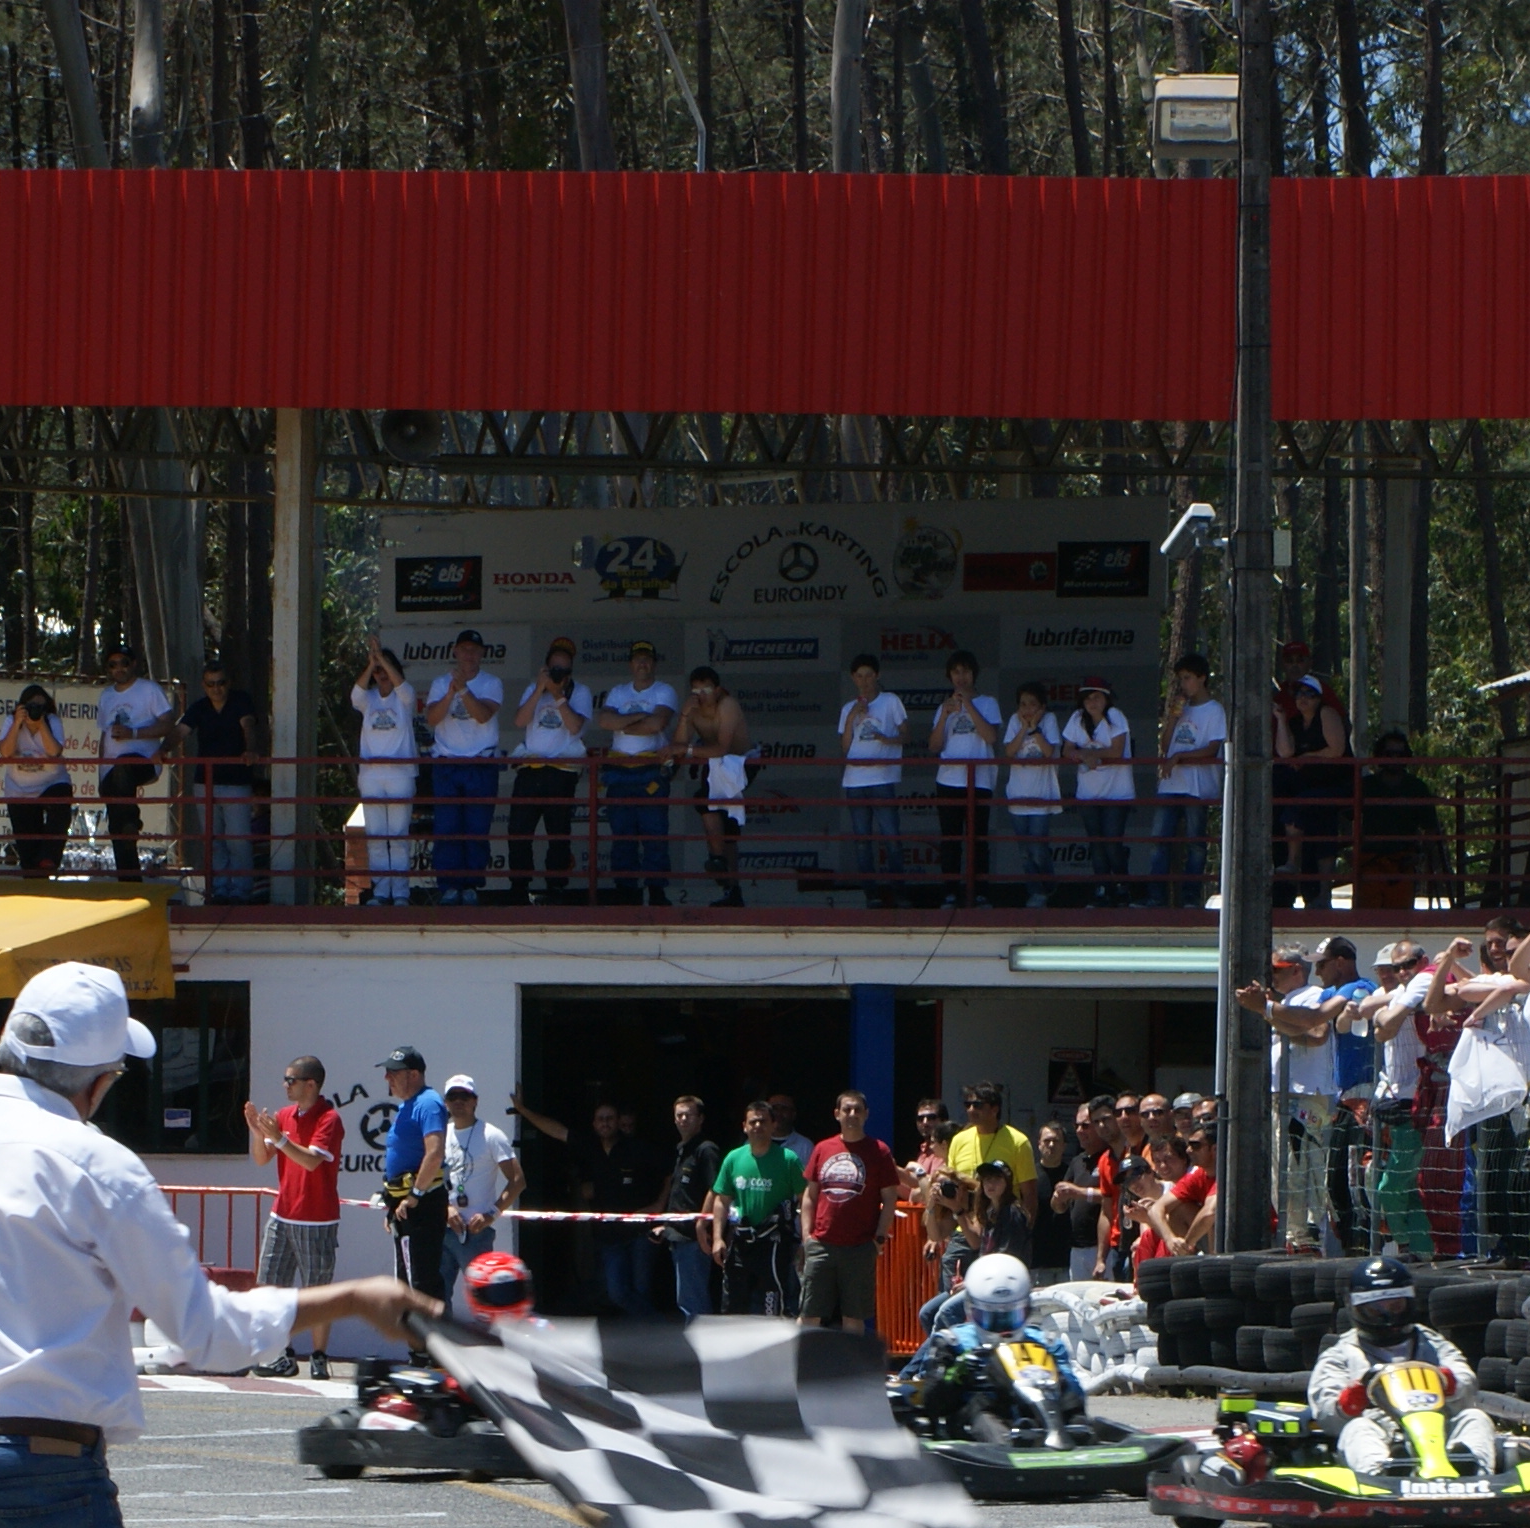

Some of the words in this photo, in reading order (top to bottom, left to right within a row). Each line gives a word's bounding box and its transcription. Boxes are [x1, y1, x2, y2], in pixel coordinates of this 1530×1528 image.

[606, 540, 657, 573] 24
[710, 526, 783, 604] ESCOLA
[798, 522, 888, 598] KARTING
[493, 572, 576, 585] HONDA
[1063, 580, 1130, 589] Motorsport
[401, 594, 464, 604] Motorsport
[754, 585, 848, 603] EUROINDY
[880, 632, 957, 651] HELIX
[1025, 627, 1135, 646] lubrifatima
[730, 641, 816, 657] MICHELIN
[82, 731, 99, 754] Ág
[679, 889, 687, 903] 2
